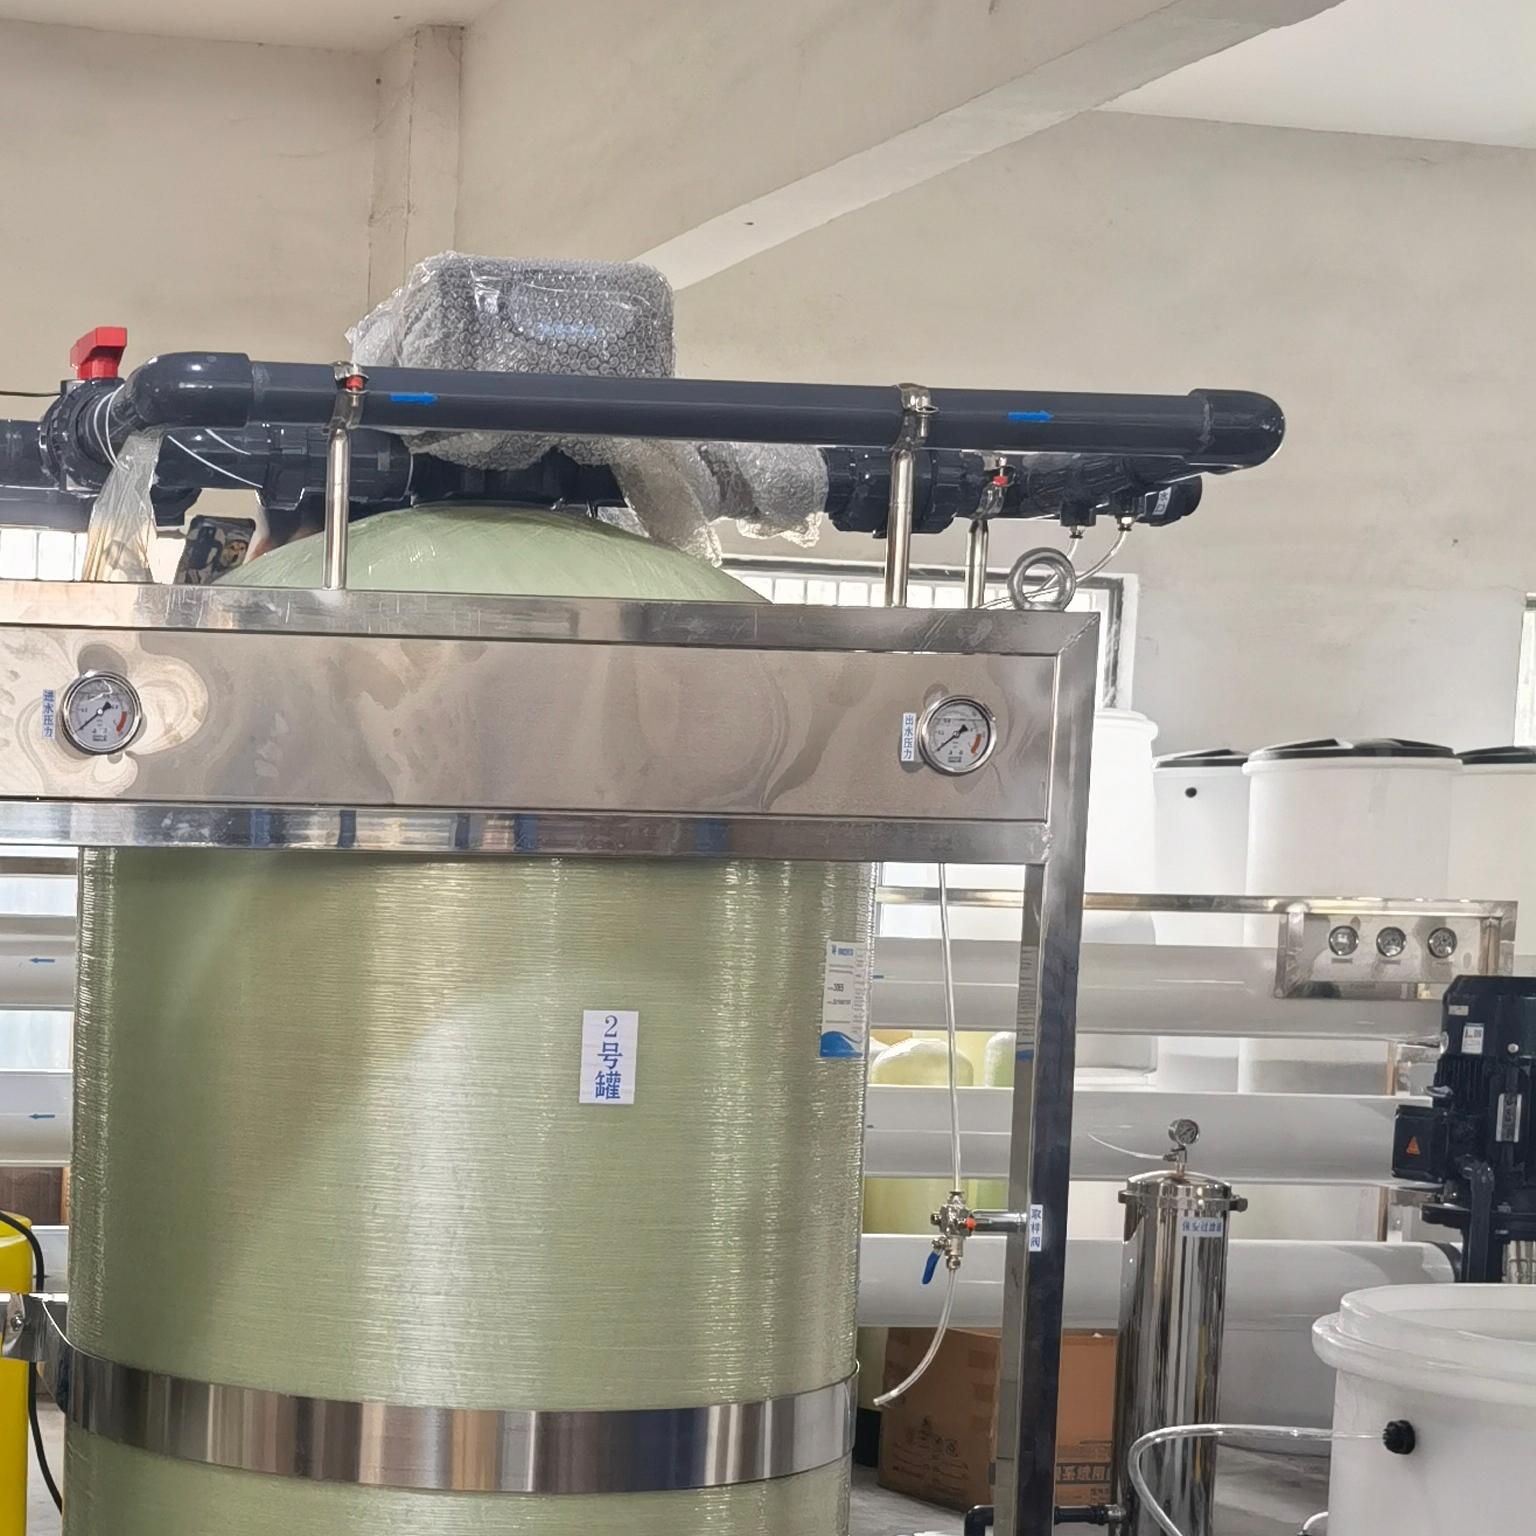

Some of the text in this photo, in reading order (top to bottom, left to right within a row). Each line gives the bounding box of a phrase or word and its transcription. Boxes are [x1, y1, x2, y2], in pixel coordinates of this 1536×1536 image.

[904, 714, 915, 760] 出水压力
[595, 1014, 623, 1100] 2号罐
[1030, 1208, 1042, 1247] 取样阀
